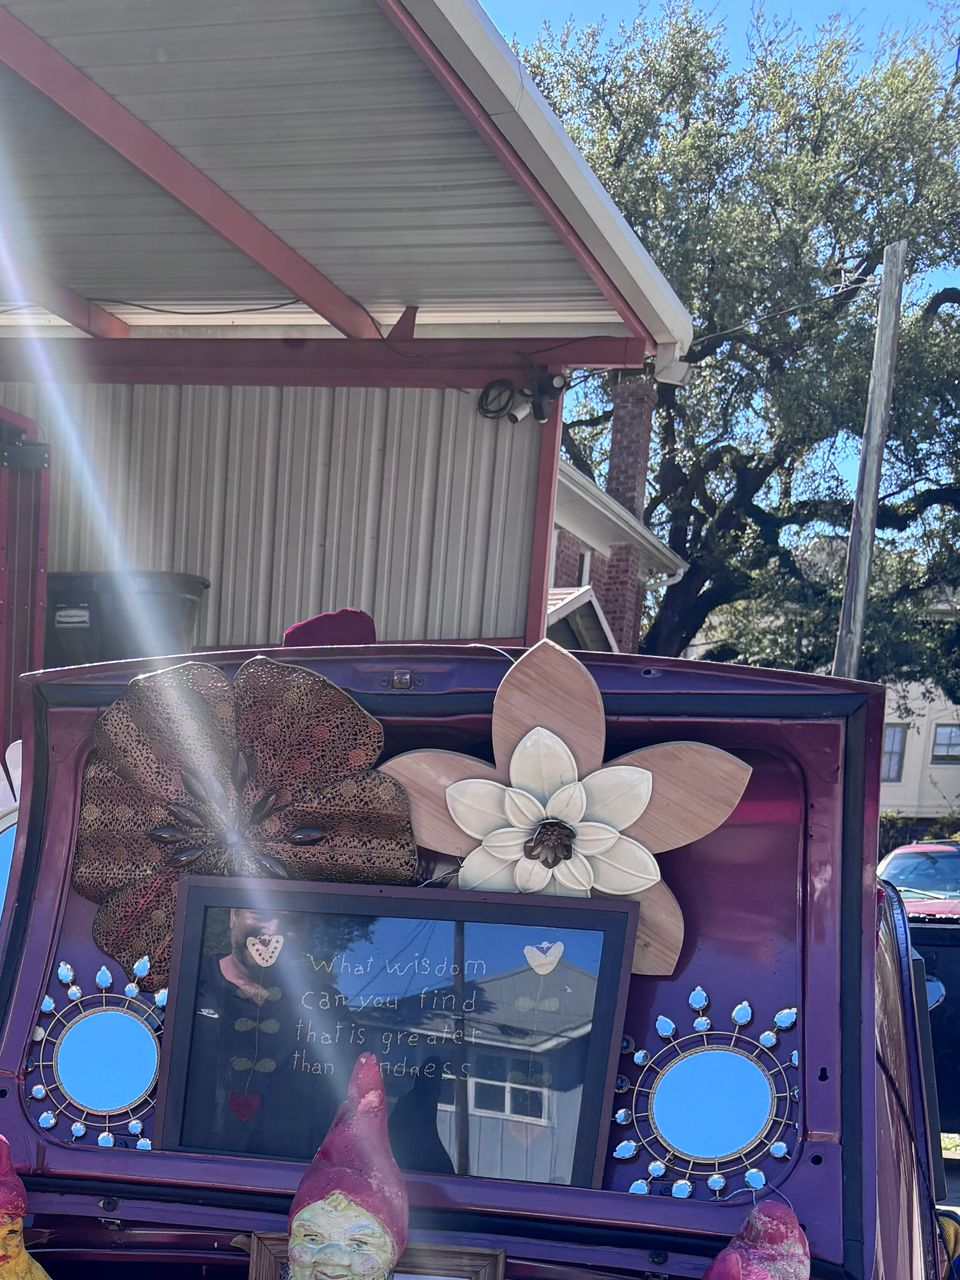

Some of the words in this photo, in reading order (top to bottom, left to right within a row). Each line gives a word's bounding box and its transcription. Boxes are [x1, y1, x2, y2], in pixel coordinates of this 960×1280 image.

[305, 952, 374, 975] What
[386, 952, 487, 977] wisdom
[359, 993, 398, 1013] you
[418, 986, 477, 1012] find
[295, 1019, 343, 1045] that
[349, 1023, 366, 1045] is
[382, 1023, 483, 1055] greater
[292, 1049, 334, 1075] than
[378, 1056, 472, 1079] ndness
